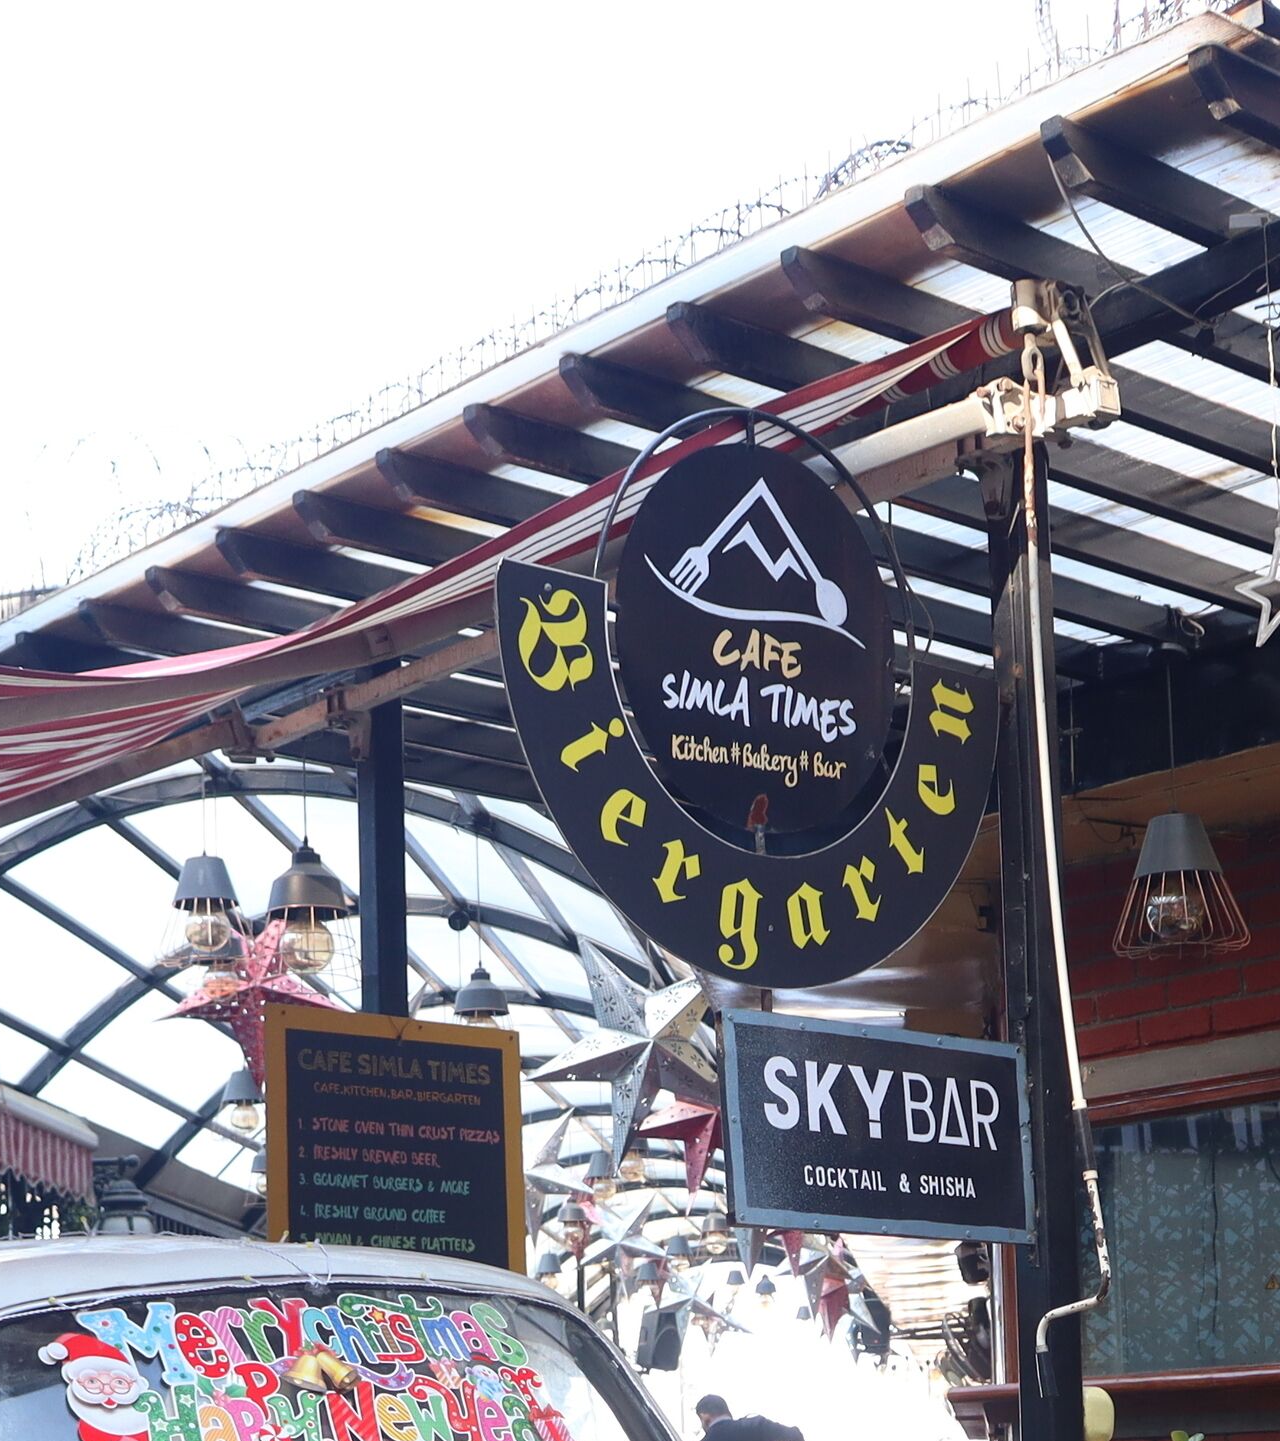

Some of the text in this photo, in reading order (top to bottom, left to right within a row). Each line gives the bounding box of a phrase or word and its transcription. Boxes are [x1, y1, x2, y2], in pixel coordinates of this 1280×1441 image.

[713, 628, 802, 679] CAFE
[662, 670, 856, 743] SIMLA TIMES
[672, 734, 729, 765] Kitchen
[743, 743, 798, 787] Bakery
[813, 752, 847, 780] Bar
[518, 589, 975, 970] Biergarten
[297, 1048, 492, 1086] CAFE SIMLA TIMES
[312, 1117, 350, 1134] STONE
[355, 1120, 385, 1136] OVEN
[388, 1122, 414, 1138] THIN
[419, 1125, 455, 1142] CRUST
[459, 1128, 501, 1145] PIZZAS
[313, 1144, 358, 1161] FRESHLY
[362, 1148, 408, 1165] BREWED
[313, 1173, 369, 1189] GOURMET
[373, 1175, 423, 1192] BURGERS
[428, 1179, 435, 1192] &
[441, 1180, 471, 1196] MORE
[804, 1164, 976, 1199] COCKTAIL & SHISHA
[314, 1203, 358, 1220] FRESHLY
[363, 1206, 407, 1223] GROUND
[412, 1209, 446, 1224] COFFEE
[370, 1234, 417, 1250] CHINESE
[421, 1237, 476, 1253] PLATTERS
[75, 1297, 308, 1386] Merry
